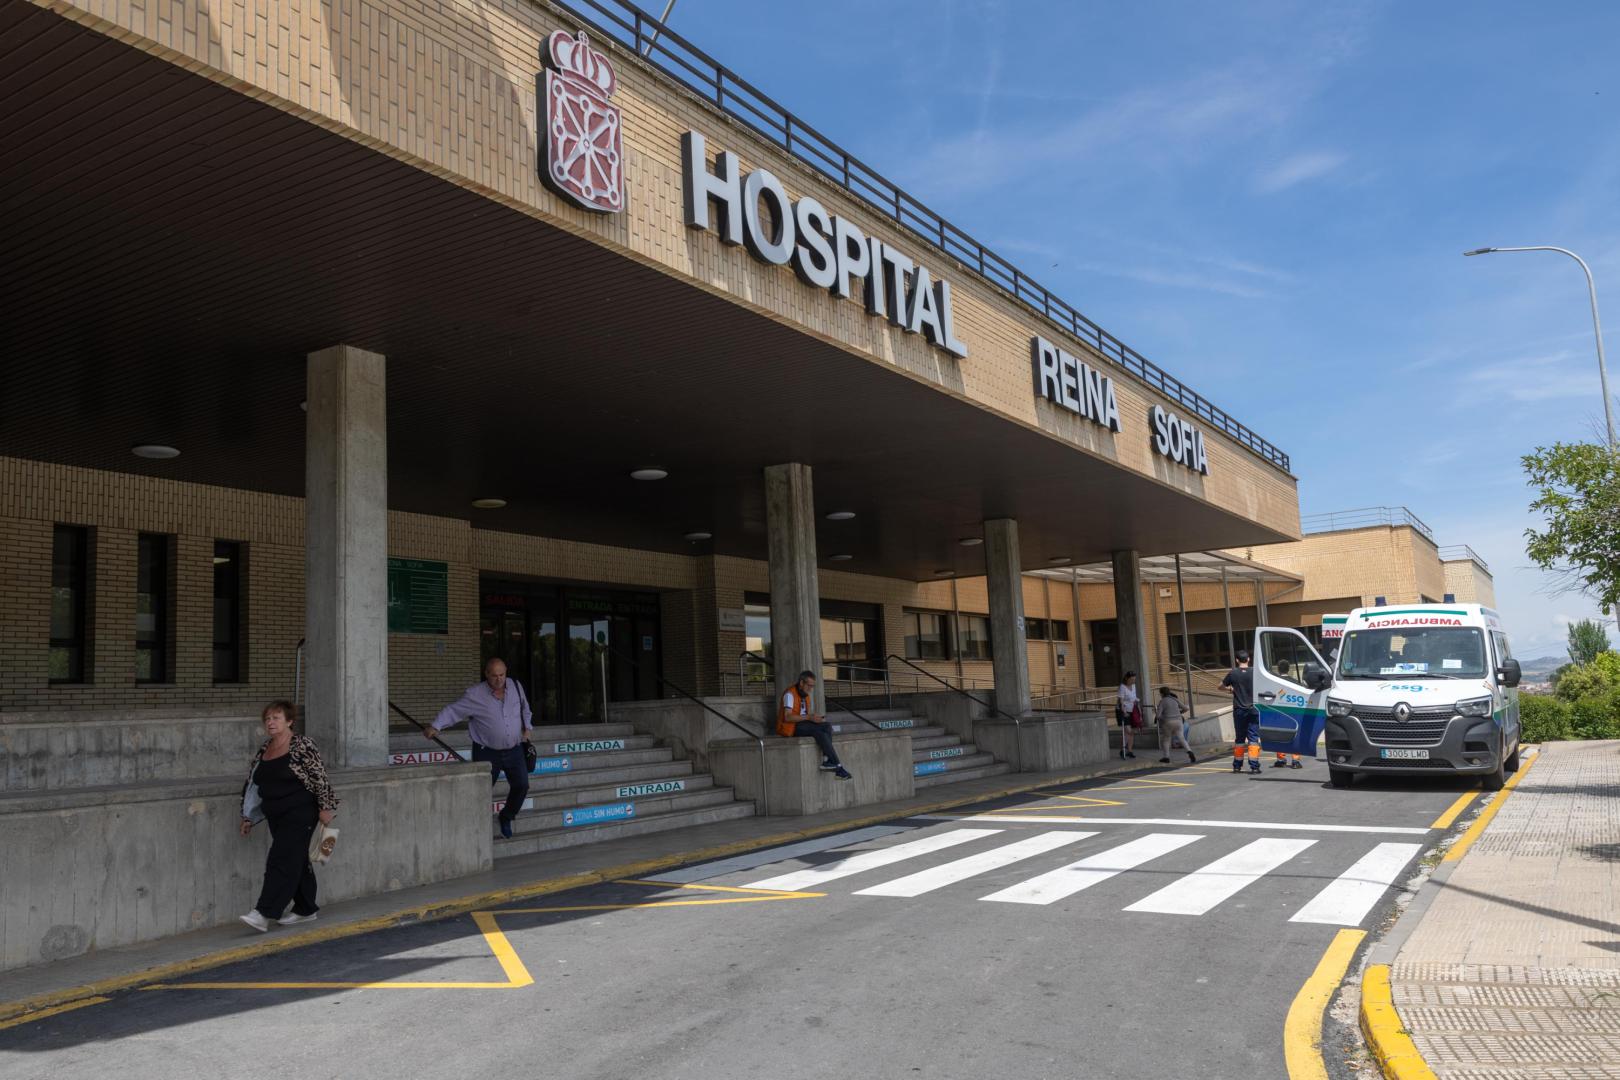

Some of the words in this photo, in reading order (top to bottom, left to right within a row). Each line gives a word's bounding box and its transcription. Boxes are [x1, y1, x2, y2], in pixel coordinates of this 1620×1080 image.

[682, 130, 967, 358] HOSPITAL
[1031, 336, 1122, 433] REINA
[1149, 404, 1209, 476] SOFIA
[558, 740, 621, 753] ENTRADA
[393, 752, 458, 765] SALIDA
[1387, 750, 1409, 758] 3005
[619, 782, 681, 797] ENTRADA
[593, 809, 605, 819] SIN
[606, 806, 625, 816] HUMO
